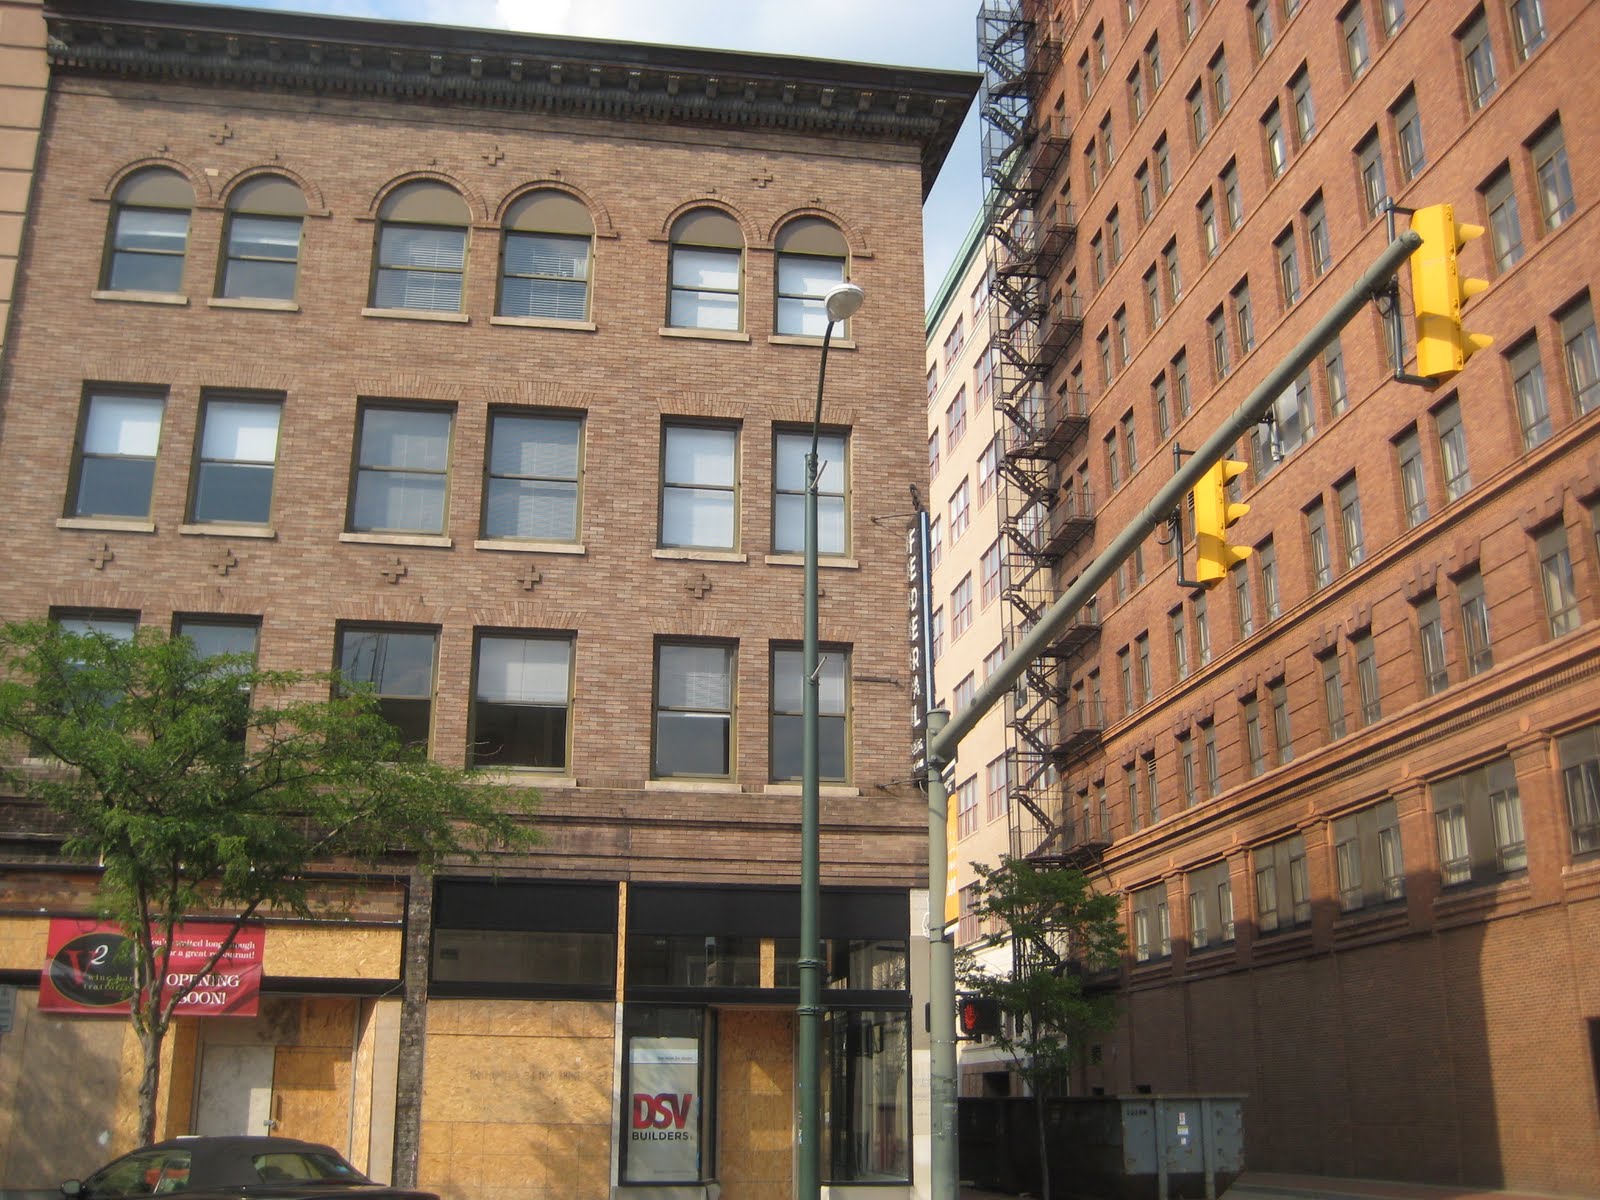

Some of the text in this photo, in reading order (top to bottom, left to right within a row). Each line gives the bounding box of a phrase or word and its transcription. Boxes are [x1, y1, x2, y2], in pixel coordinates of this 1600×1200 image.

[907, 527, 921, 728] FEDERAL
[185, 950, 207, 958] great
[632, 1093, 693, 1130] DSV
[631, 1131, 689, 1141] BUILDERS
